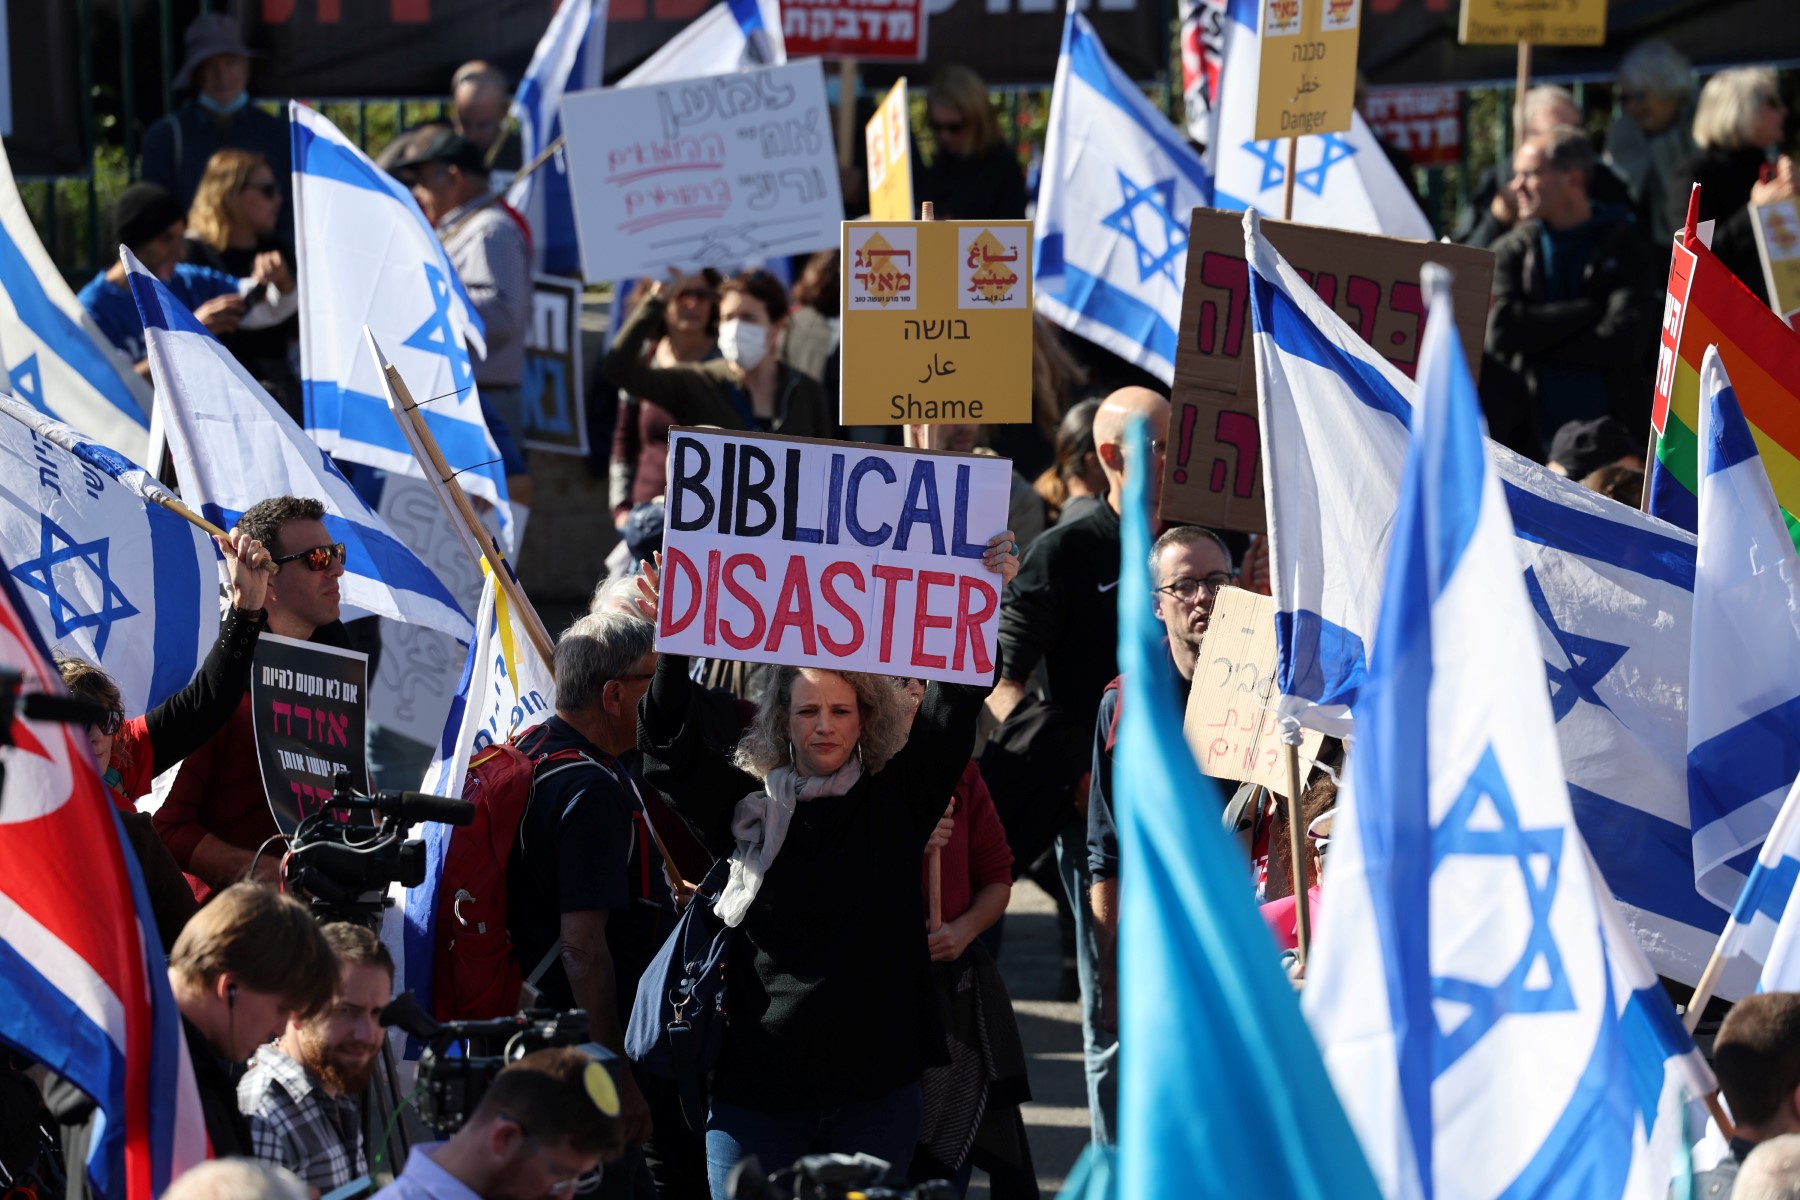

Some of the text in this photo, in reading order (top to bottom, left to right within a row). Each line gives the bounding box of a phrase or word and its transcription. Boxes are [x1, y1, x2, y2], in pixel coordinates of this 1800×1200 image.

[784, 8, 914, 42] מדבקת
[1292, 42, 1326, 63] סכנה
[1280, 109, 1328, 133] Danger
[854, 249, 911, 268] תג
[854, 272, 911, 292] מאיר
[904, 319, 971, 340] בושה
[918, 352, 957, 384] عار
[890, 393, 984, 420] Shame
[670, 437, 990, 559] BIBLICAL
[660, 546, 999, 674] DISASTER
[262, 666, 358, 703] אם לא תקום להיות
[272, 699, 349, 748] אזרח
[277, 749, 305, 772] אותך
[305, 755, 331, 778] יעשו
